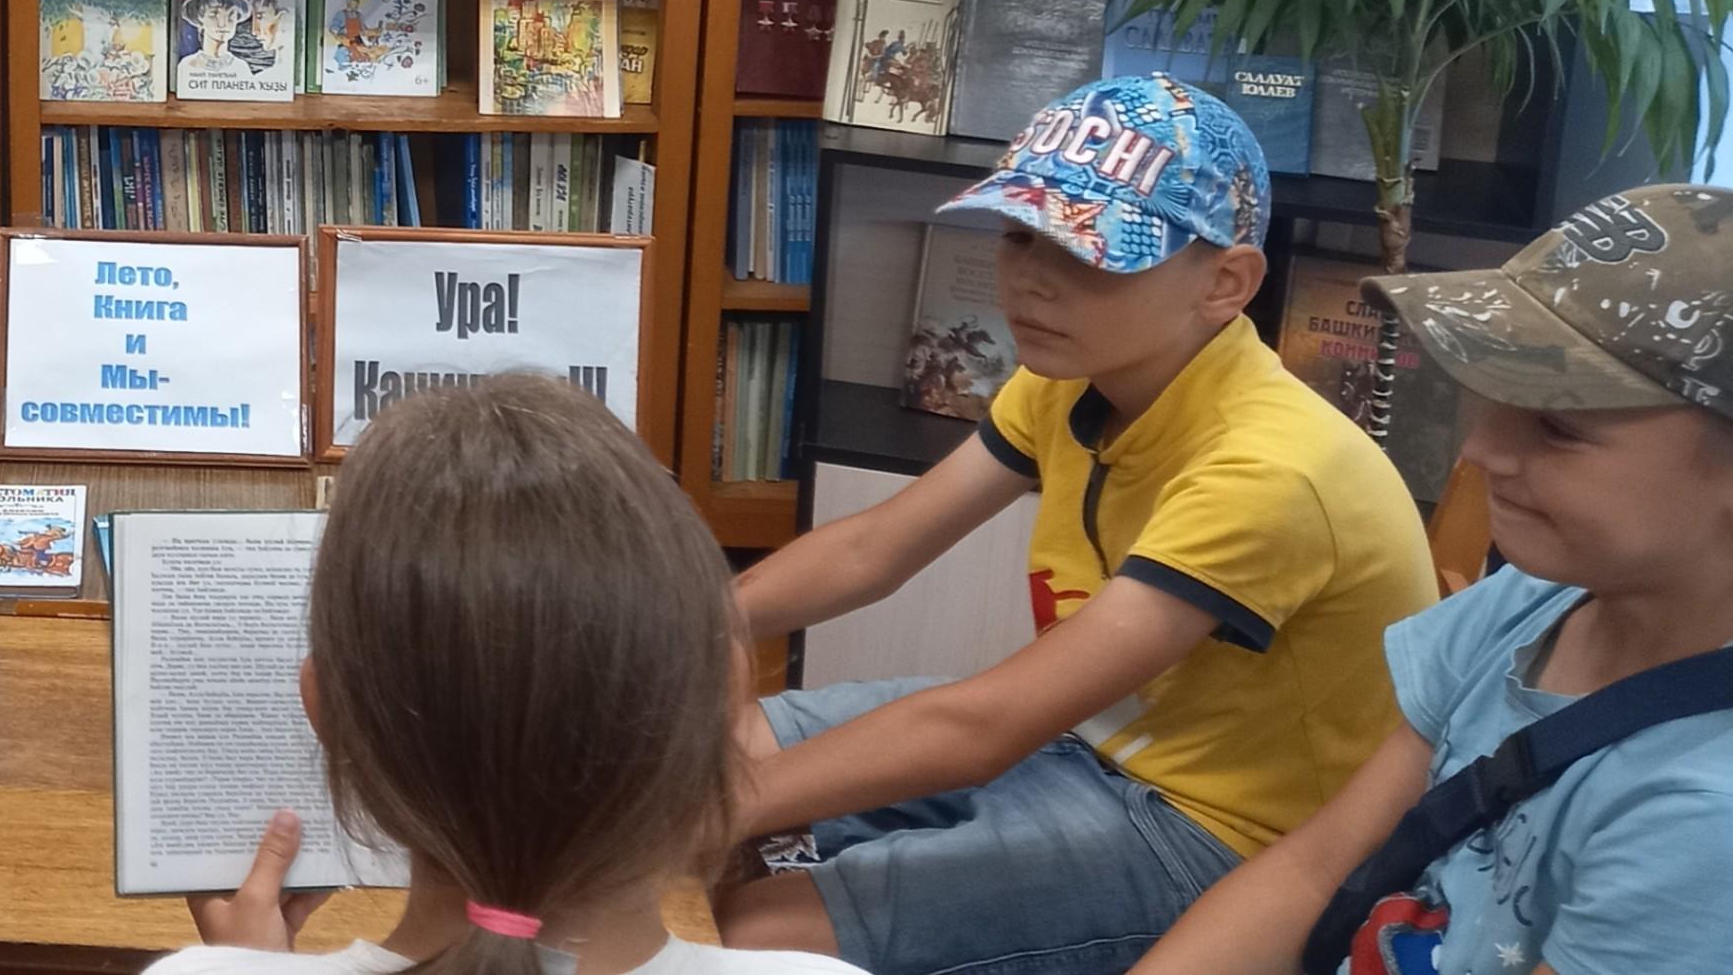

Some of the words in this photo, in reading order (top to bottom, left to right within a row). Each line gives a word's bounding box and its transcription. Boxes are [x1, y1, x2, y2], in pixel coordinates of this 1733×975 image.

[188, 79, 209, 90] СИТ
[211, 80, 256, 91] ПЛАНЕТА
[1234, 71, 1305, 86] САЛАУАТ
[1240, 82, 1297, 99] ЮЛАЕВ
[94, 261, 180, 291] Лето,
[93, 294, 188, 323] Книга
[434, 271, 520, 340] Ура!
[124, 334, 146, 355] и
[99, 364, 171, 392] Мы-
[20, 398, 251, 431] совместимы!
